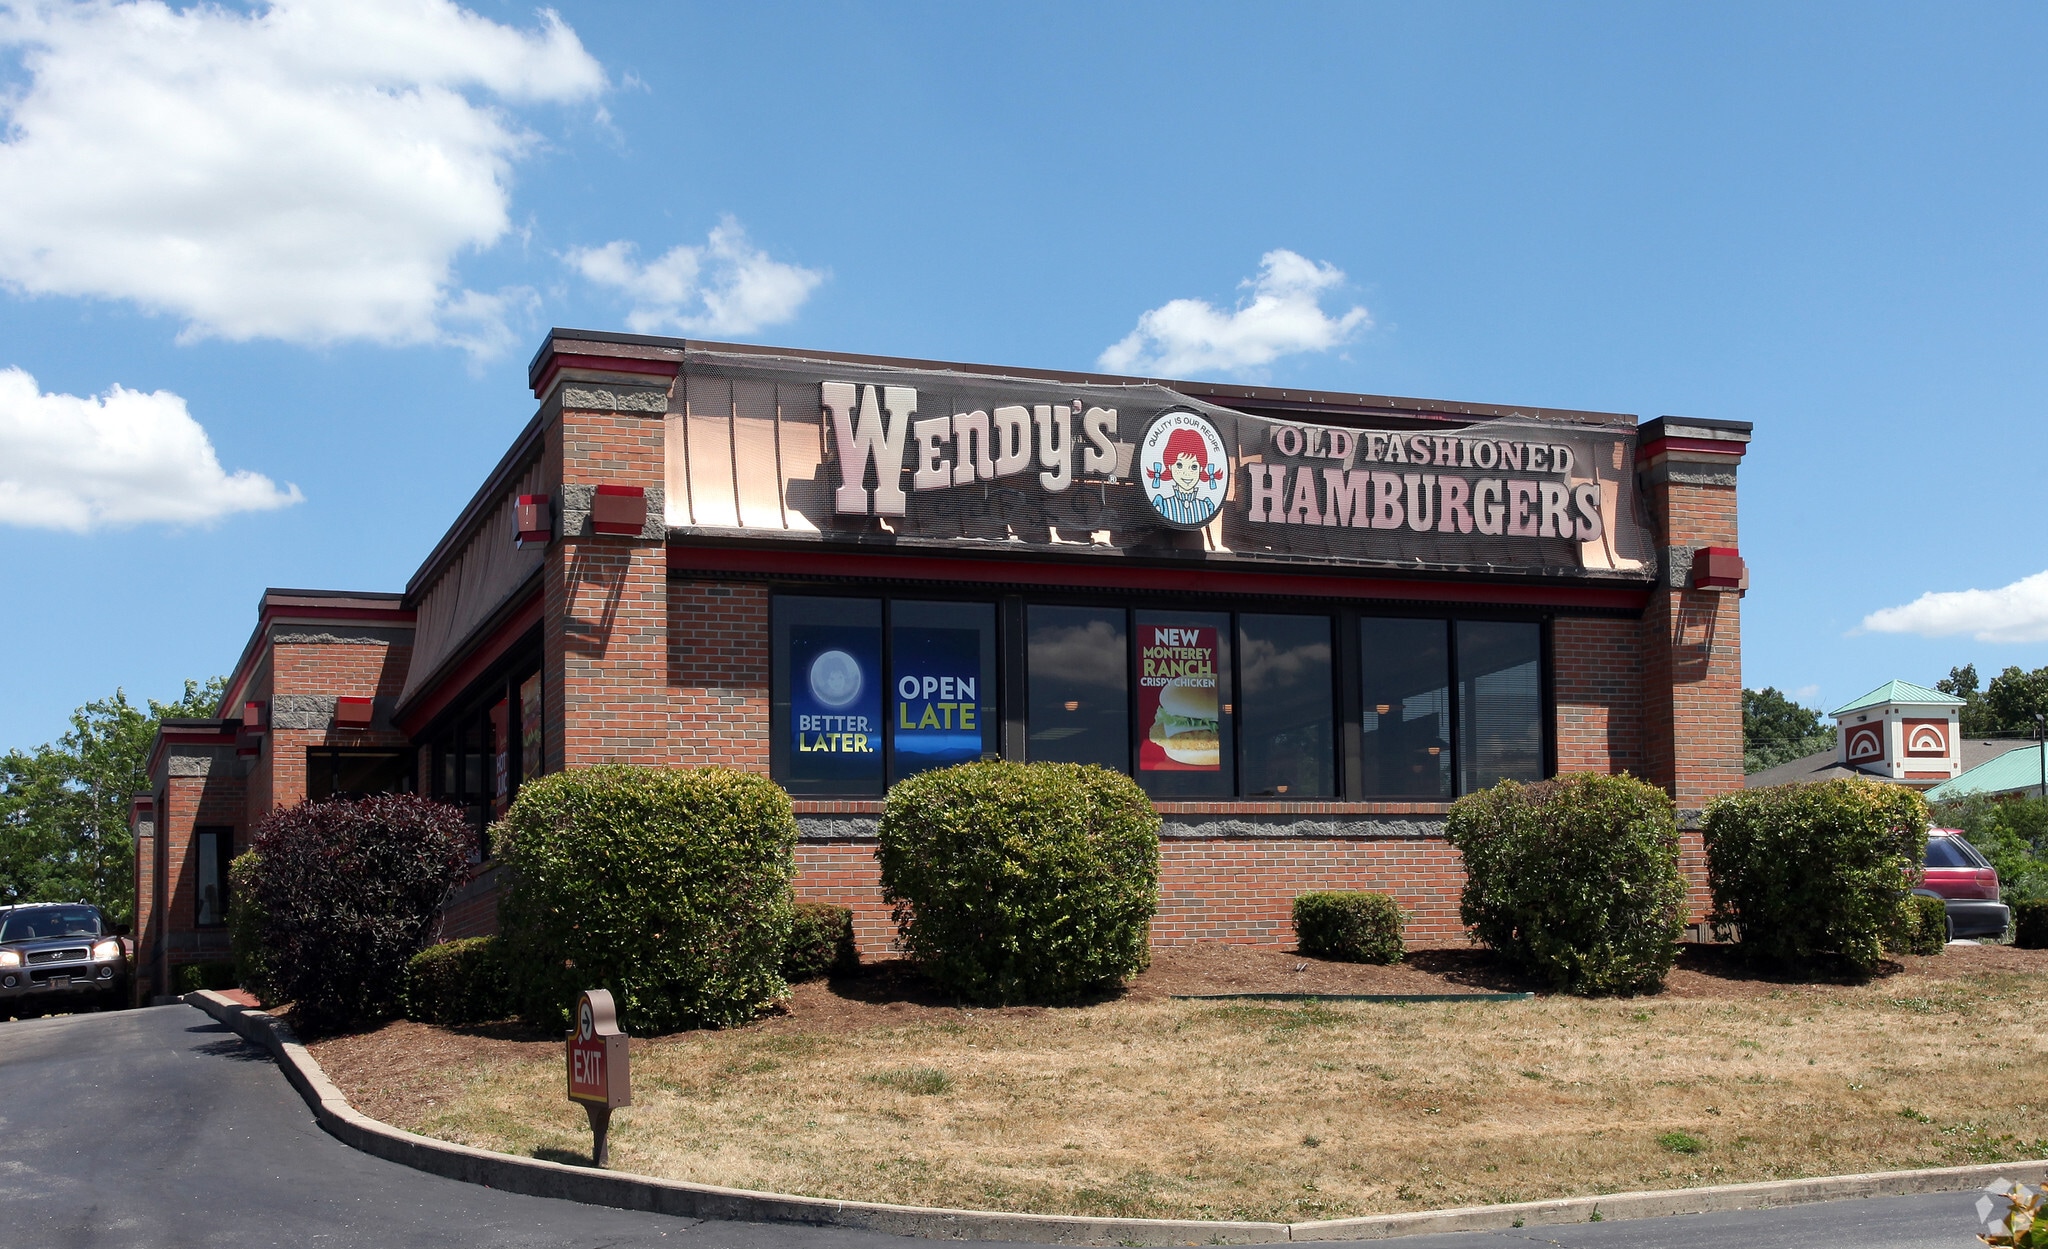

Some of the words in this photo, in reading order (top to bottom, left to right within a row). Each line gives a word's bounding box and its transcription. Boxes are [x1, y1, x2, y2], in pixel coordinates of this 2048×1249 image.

[1149, 419, 1172, 447] QUALITY
[1174, 416, 1182, 424] IS
[1183, 417, 1200, 428] OUR
[1201, 425, 1220, 452] RECIPE
[1275, 425, 1353, 459] OLD
[1365, 431, 1575, 474] FASHIONED
[1247, 462, 1602, 541] HAMBURGERS
[1155, 628, 1199, 647] NEW
[1143, 646, 1211, 660] MONTEREY
[1143, 659, 1212, 678] RANCH
[899, 675, 975, 700] OPEN
[1140, 677, 1173, 687] CRISPY
[1174, 677, 1216, 688] CHICKEN
[800, 715, 873, 732] BETTER.
[900, 702, 976, 730] LATE
[800, 732, 873, 752] LATER.
[574, 1049, 601, 1086] EXIT
